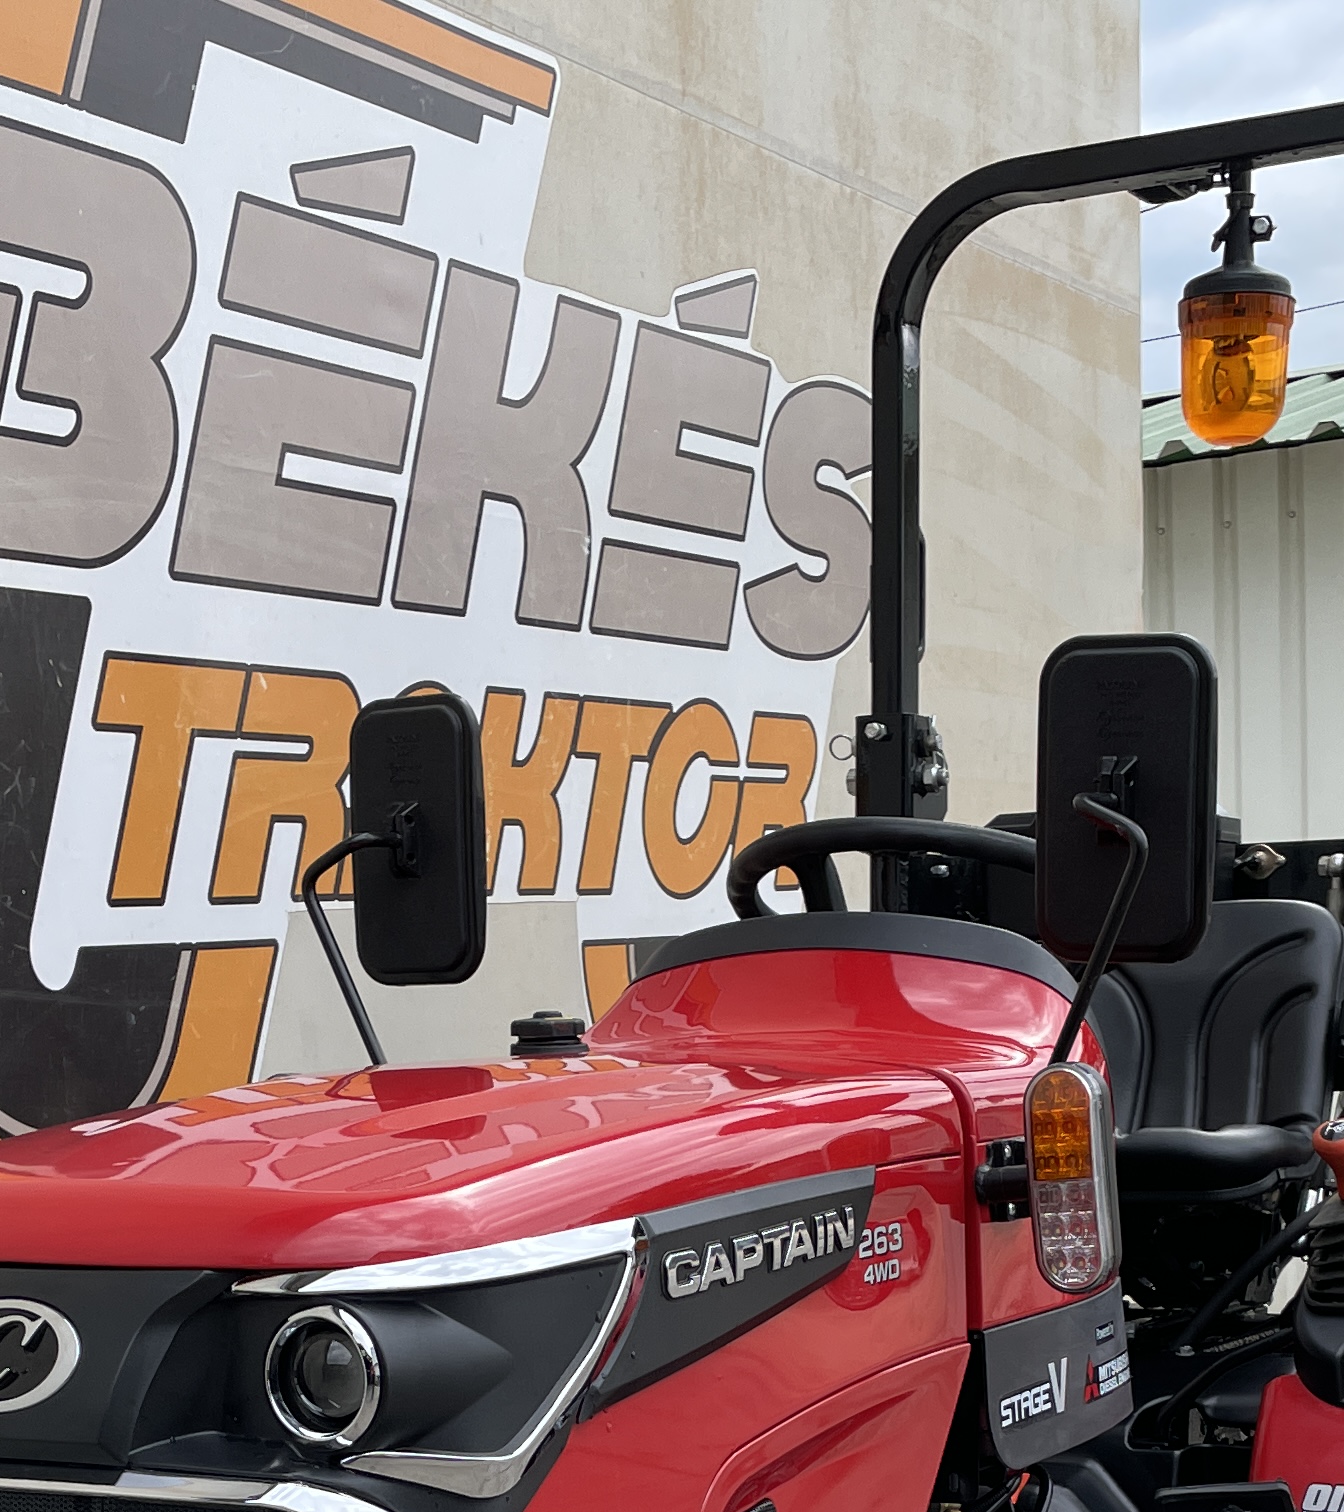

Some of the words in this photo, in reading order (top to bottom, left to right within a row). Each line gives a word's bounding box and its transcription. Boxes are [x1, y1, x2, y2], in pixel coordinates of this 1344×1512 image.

[93, 651, 818, 905] TRKTOR
[663, 1205, 855, 1299] CAPTAIN
[858, 1223, 903, 1259] 263
[863, 1258, 900, 1285] 4WD
[1000, 1383, 1052, 1428] STAGE
